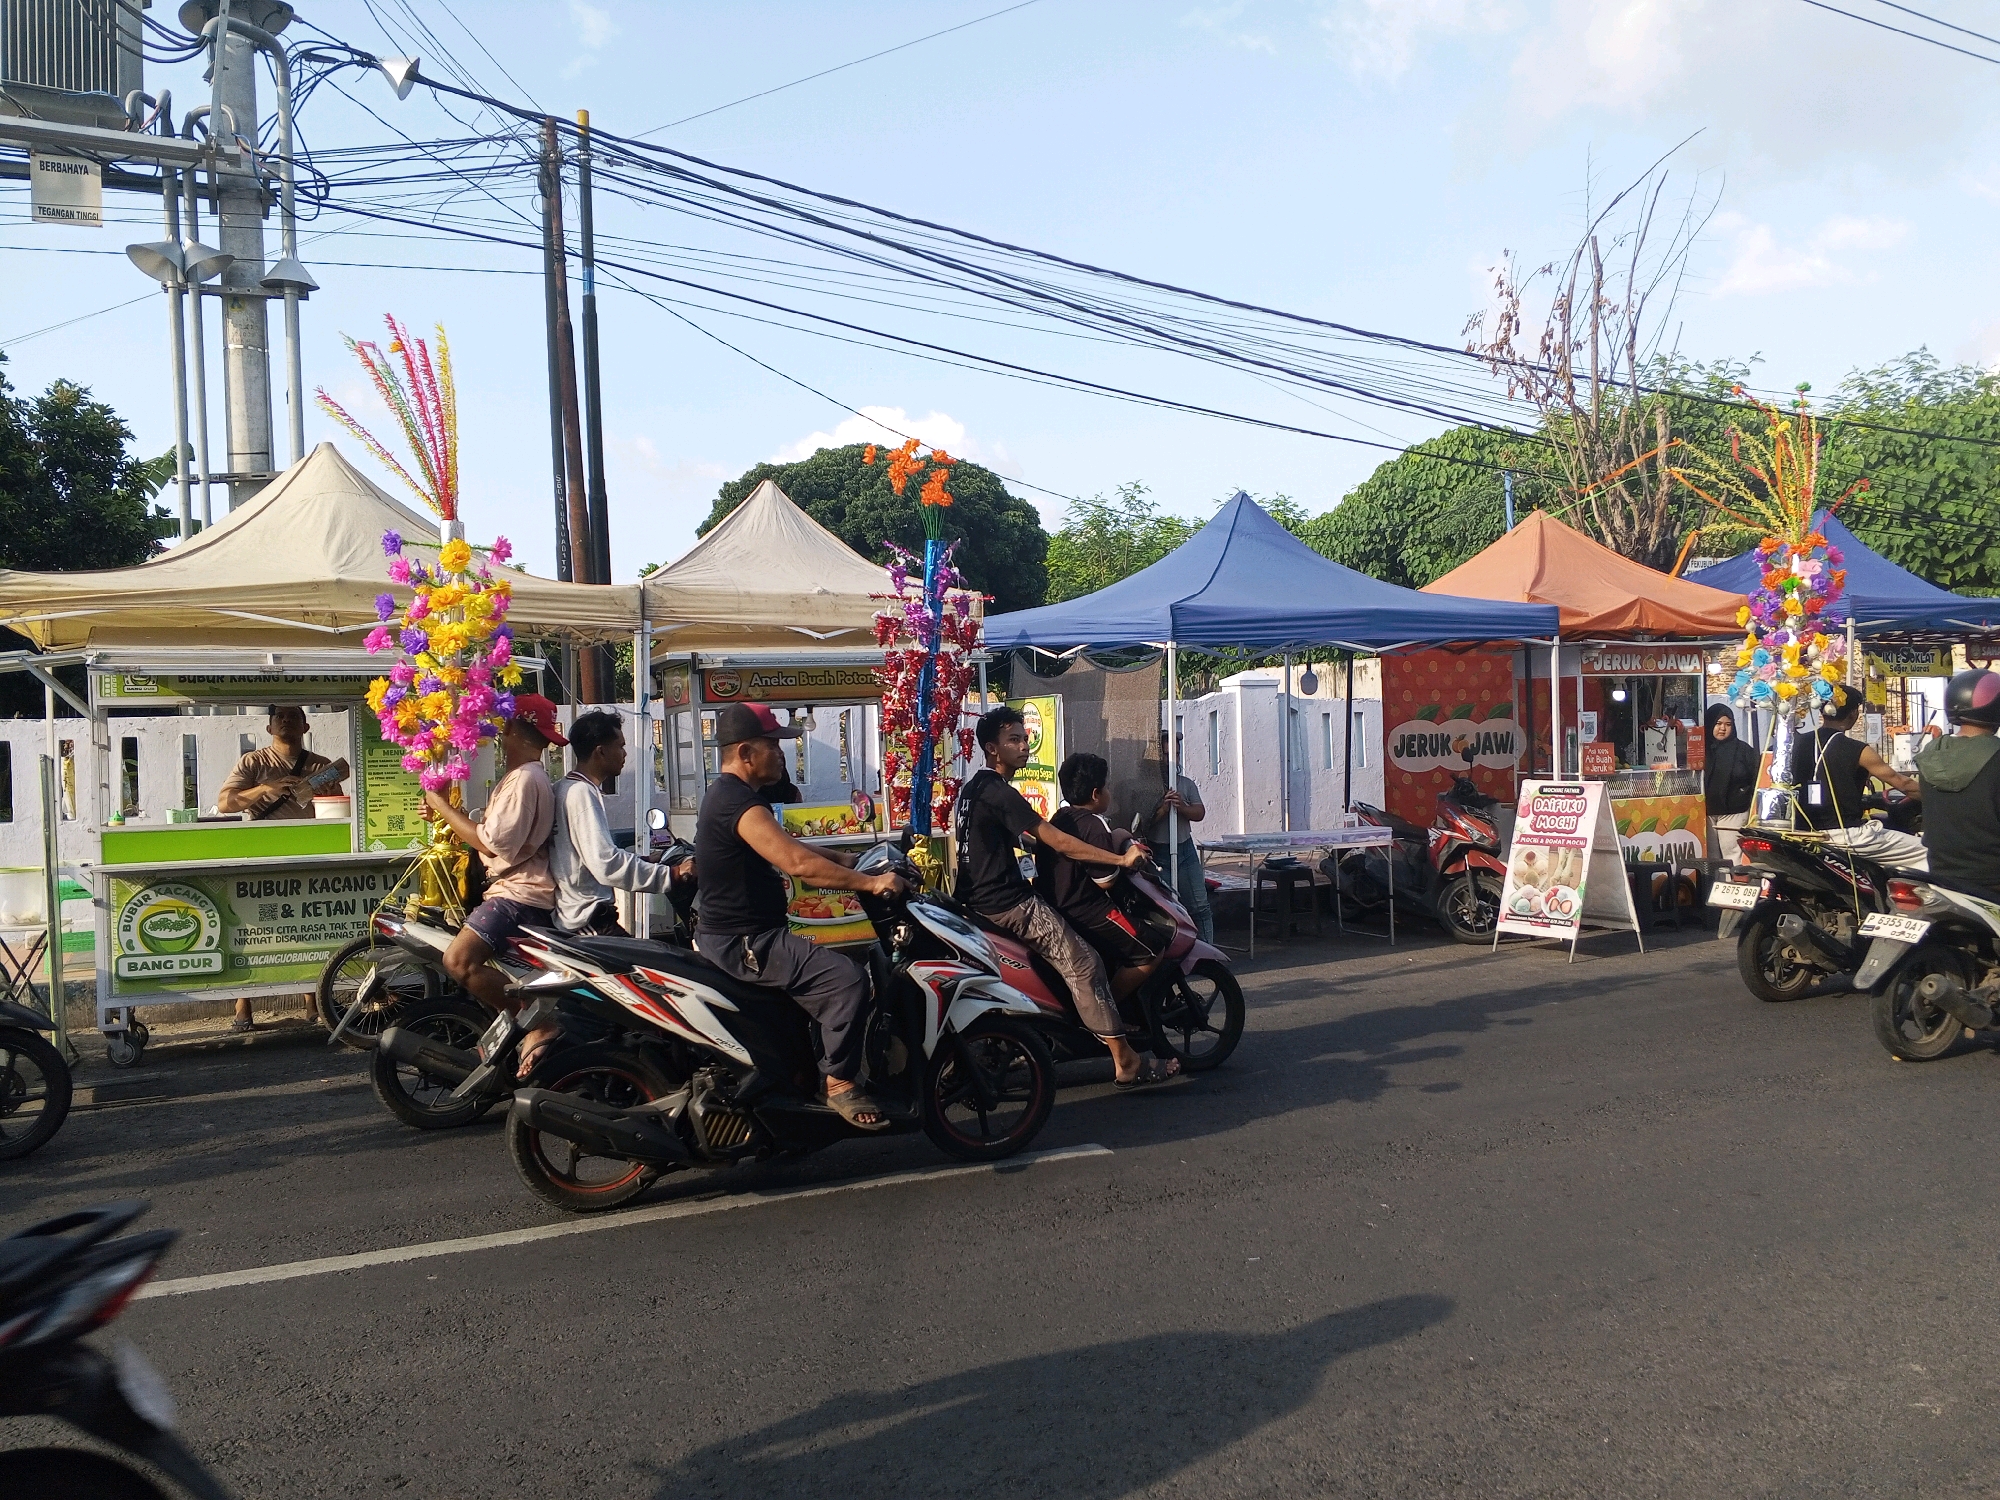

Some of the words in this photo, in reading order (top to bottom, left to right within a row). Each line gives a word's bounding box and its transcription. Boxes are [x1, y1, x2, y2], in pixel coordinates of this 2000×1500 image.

[39, 159, 89, 176] BERBAHAYA
[38, 206, 75, 220] TEGANGAN
[76, 211, 99, 221] TINGGI
[1593, 653, 1642, 671] JERUK
[1657, 653, 1701, 671] JAWA
[750, 671, 797, 687] Aneka
[799, 671, 835, 686] Buah
[382, 749, 405, 757] MENU
[1393, 732, 1452, 759] JERUK
[1585, 755, 1595, 764] Air
[1595, 754, 1613, 764] Buah
[1040, 767, 1054, 780] Segar
[1590, 764, 1608, 773] Jeruk
[1655, 841, 1696, 864] JAWA
[236, 878, 302, 898] BUBUR
[308, 875, 376, 895] KACANG
[1714, 884, 1720, 892] P
[1721, 885, 1741, 896] 2675
[123, 893, 152, 932] BUBUR
[153, 886, 209, 909] KACANG
[204, 908, 218, 928] IJO
[280, 903, 295, 919] &
[301, 898, 357, 918] KETAN
[237, 925, 274, 937] TRADISI
[276, 924, 298, 935] CITA
[300, 922, 326, 934] RASA
[328, 921, 348, 931] TAK
[1867, 914, 1876, 923] P
[1877, 916, 1904, 928] 6355
[234, 936, 272, 946] NIKMAT
[275, 933, 322, 944] DISAJIKAN
[324, 930, 355, 940] PANAS
[127, 960, 174, 972] BANG
[178, 958, 213, 969] DUR
